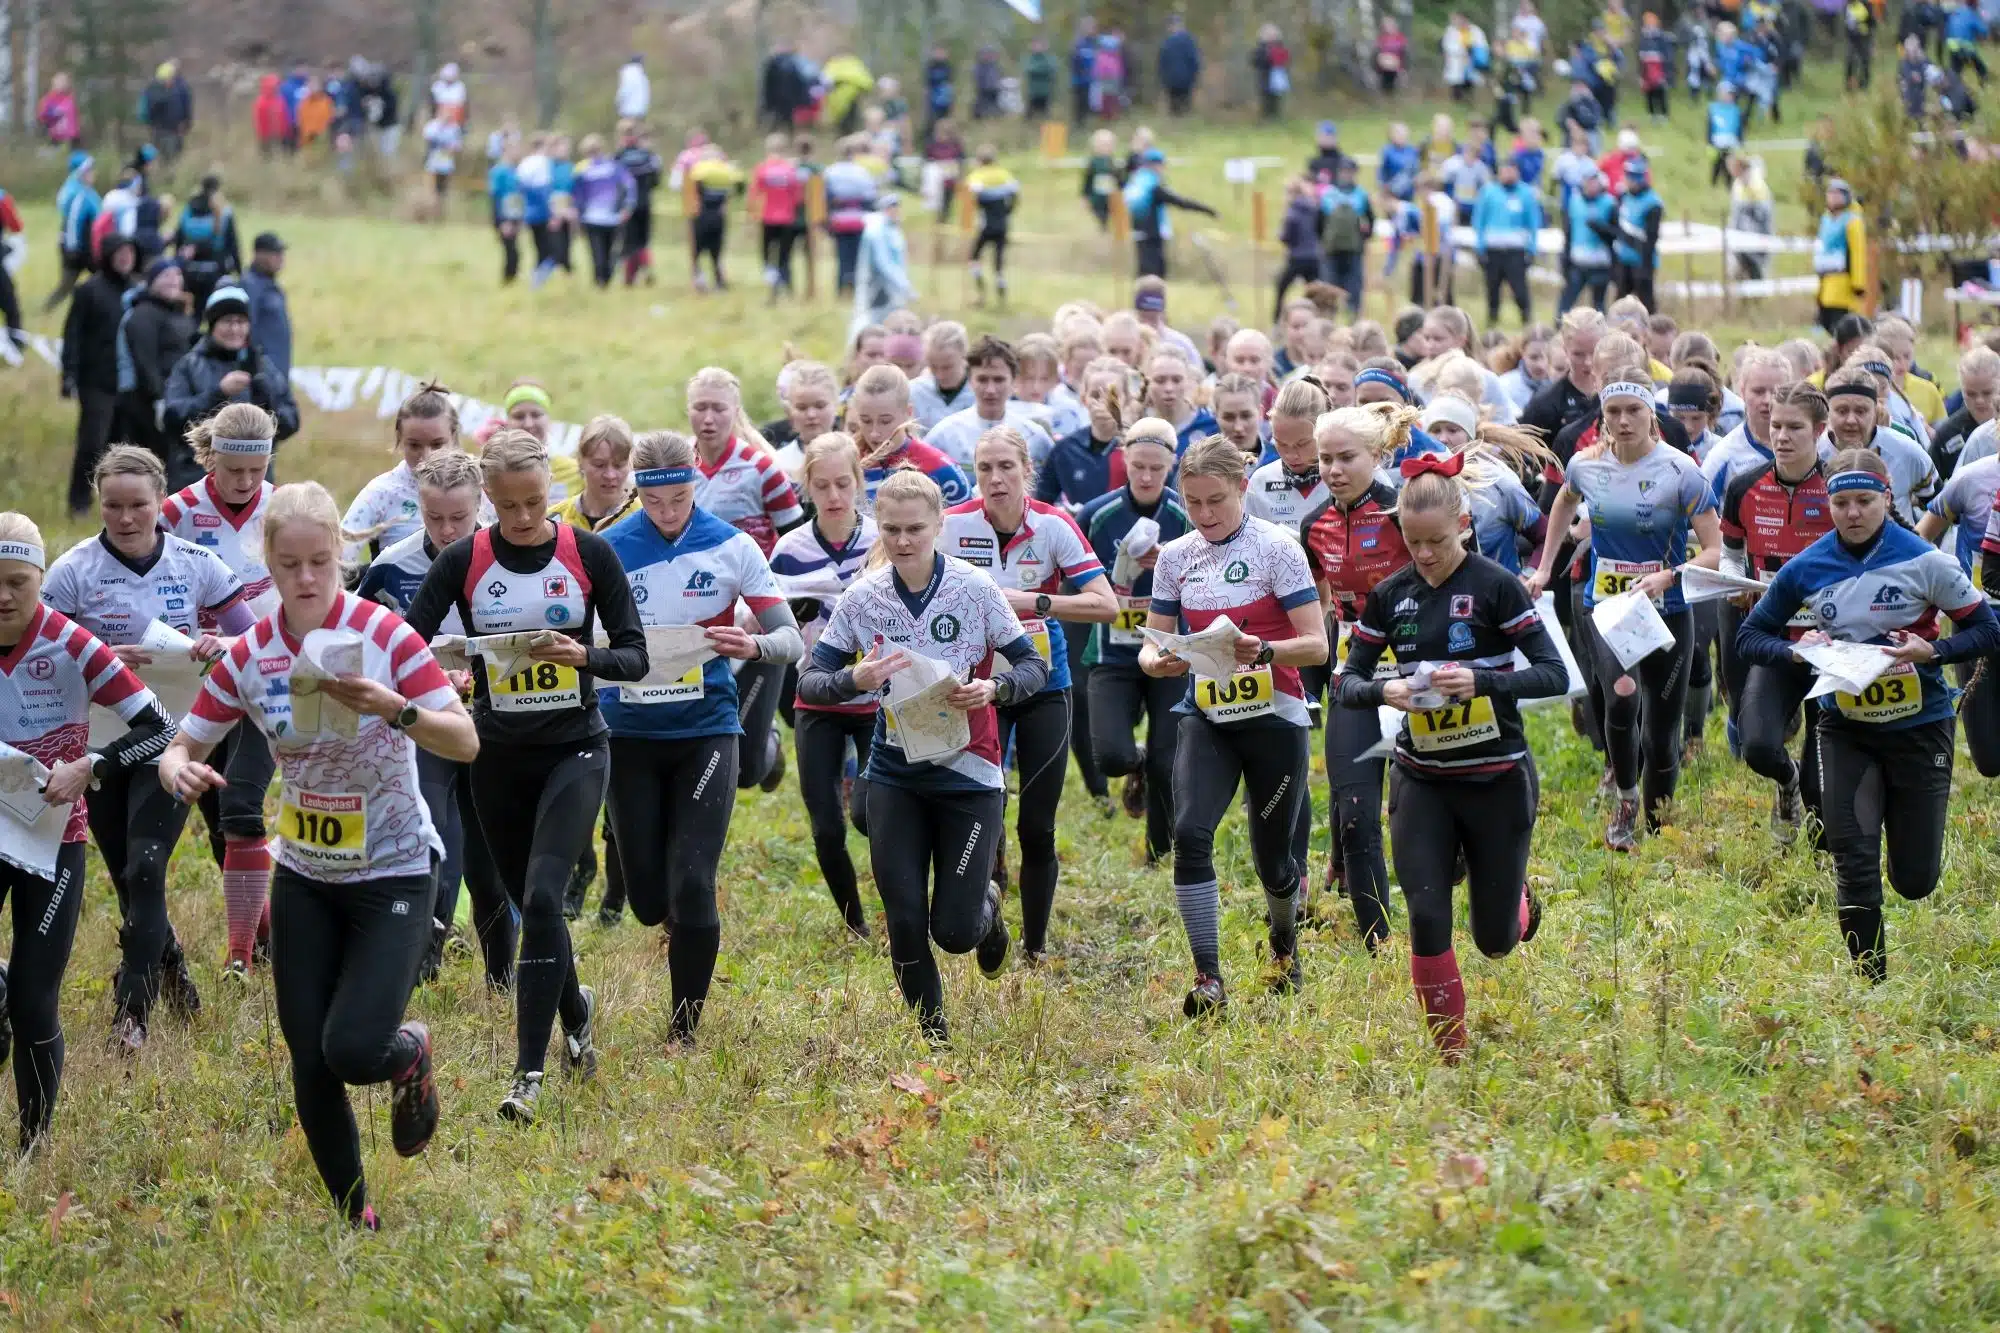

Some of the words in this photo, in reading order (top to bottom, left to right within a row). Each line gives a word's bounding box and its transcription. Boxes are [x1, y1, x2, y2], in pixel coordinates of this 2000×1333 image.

[666, 471, 686, 479] Havu
[1757, 527, 1780, 537] ABLOY
[176, 546, 209, 558] TRIMTEX
[920, 572, 938, 604] noname
[476, 606, 524, 617] kisakallio
[101, 623, 129, 632] ABLOY
[484, 621, 513, 629] TRIMTEX
[22, 688, 62, 696] noname
[642, 686, 700, 697] KOUVOLA
[1206, 676, 1260, 706] 109
[1854, 679, 1907, 707] 103
[21, 701, 64, 711] LUMNITE
[515, 693, 577, 705] KOUVOLA
[1217, 701, 1271, 717] KOUVOLA
[1421, 699, 1473, 733] 127
[1863, 703, 1919, 718] KOUVOLA
[1436, 726, 1495, 744] KOUVOLA
[691, 750, 721, 801] noname
[302, 795, 357, 810] Leukoplast
[1260, 774, 1291, 820] noname
[295, 811, 343, 847] 110
[299, 847, 362, 861] KOUVOLA
[955, 821, 982, 876] noname
[37, 866, 72, 937] noname
